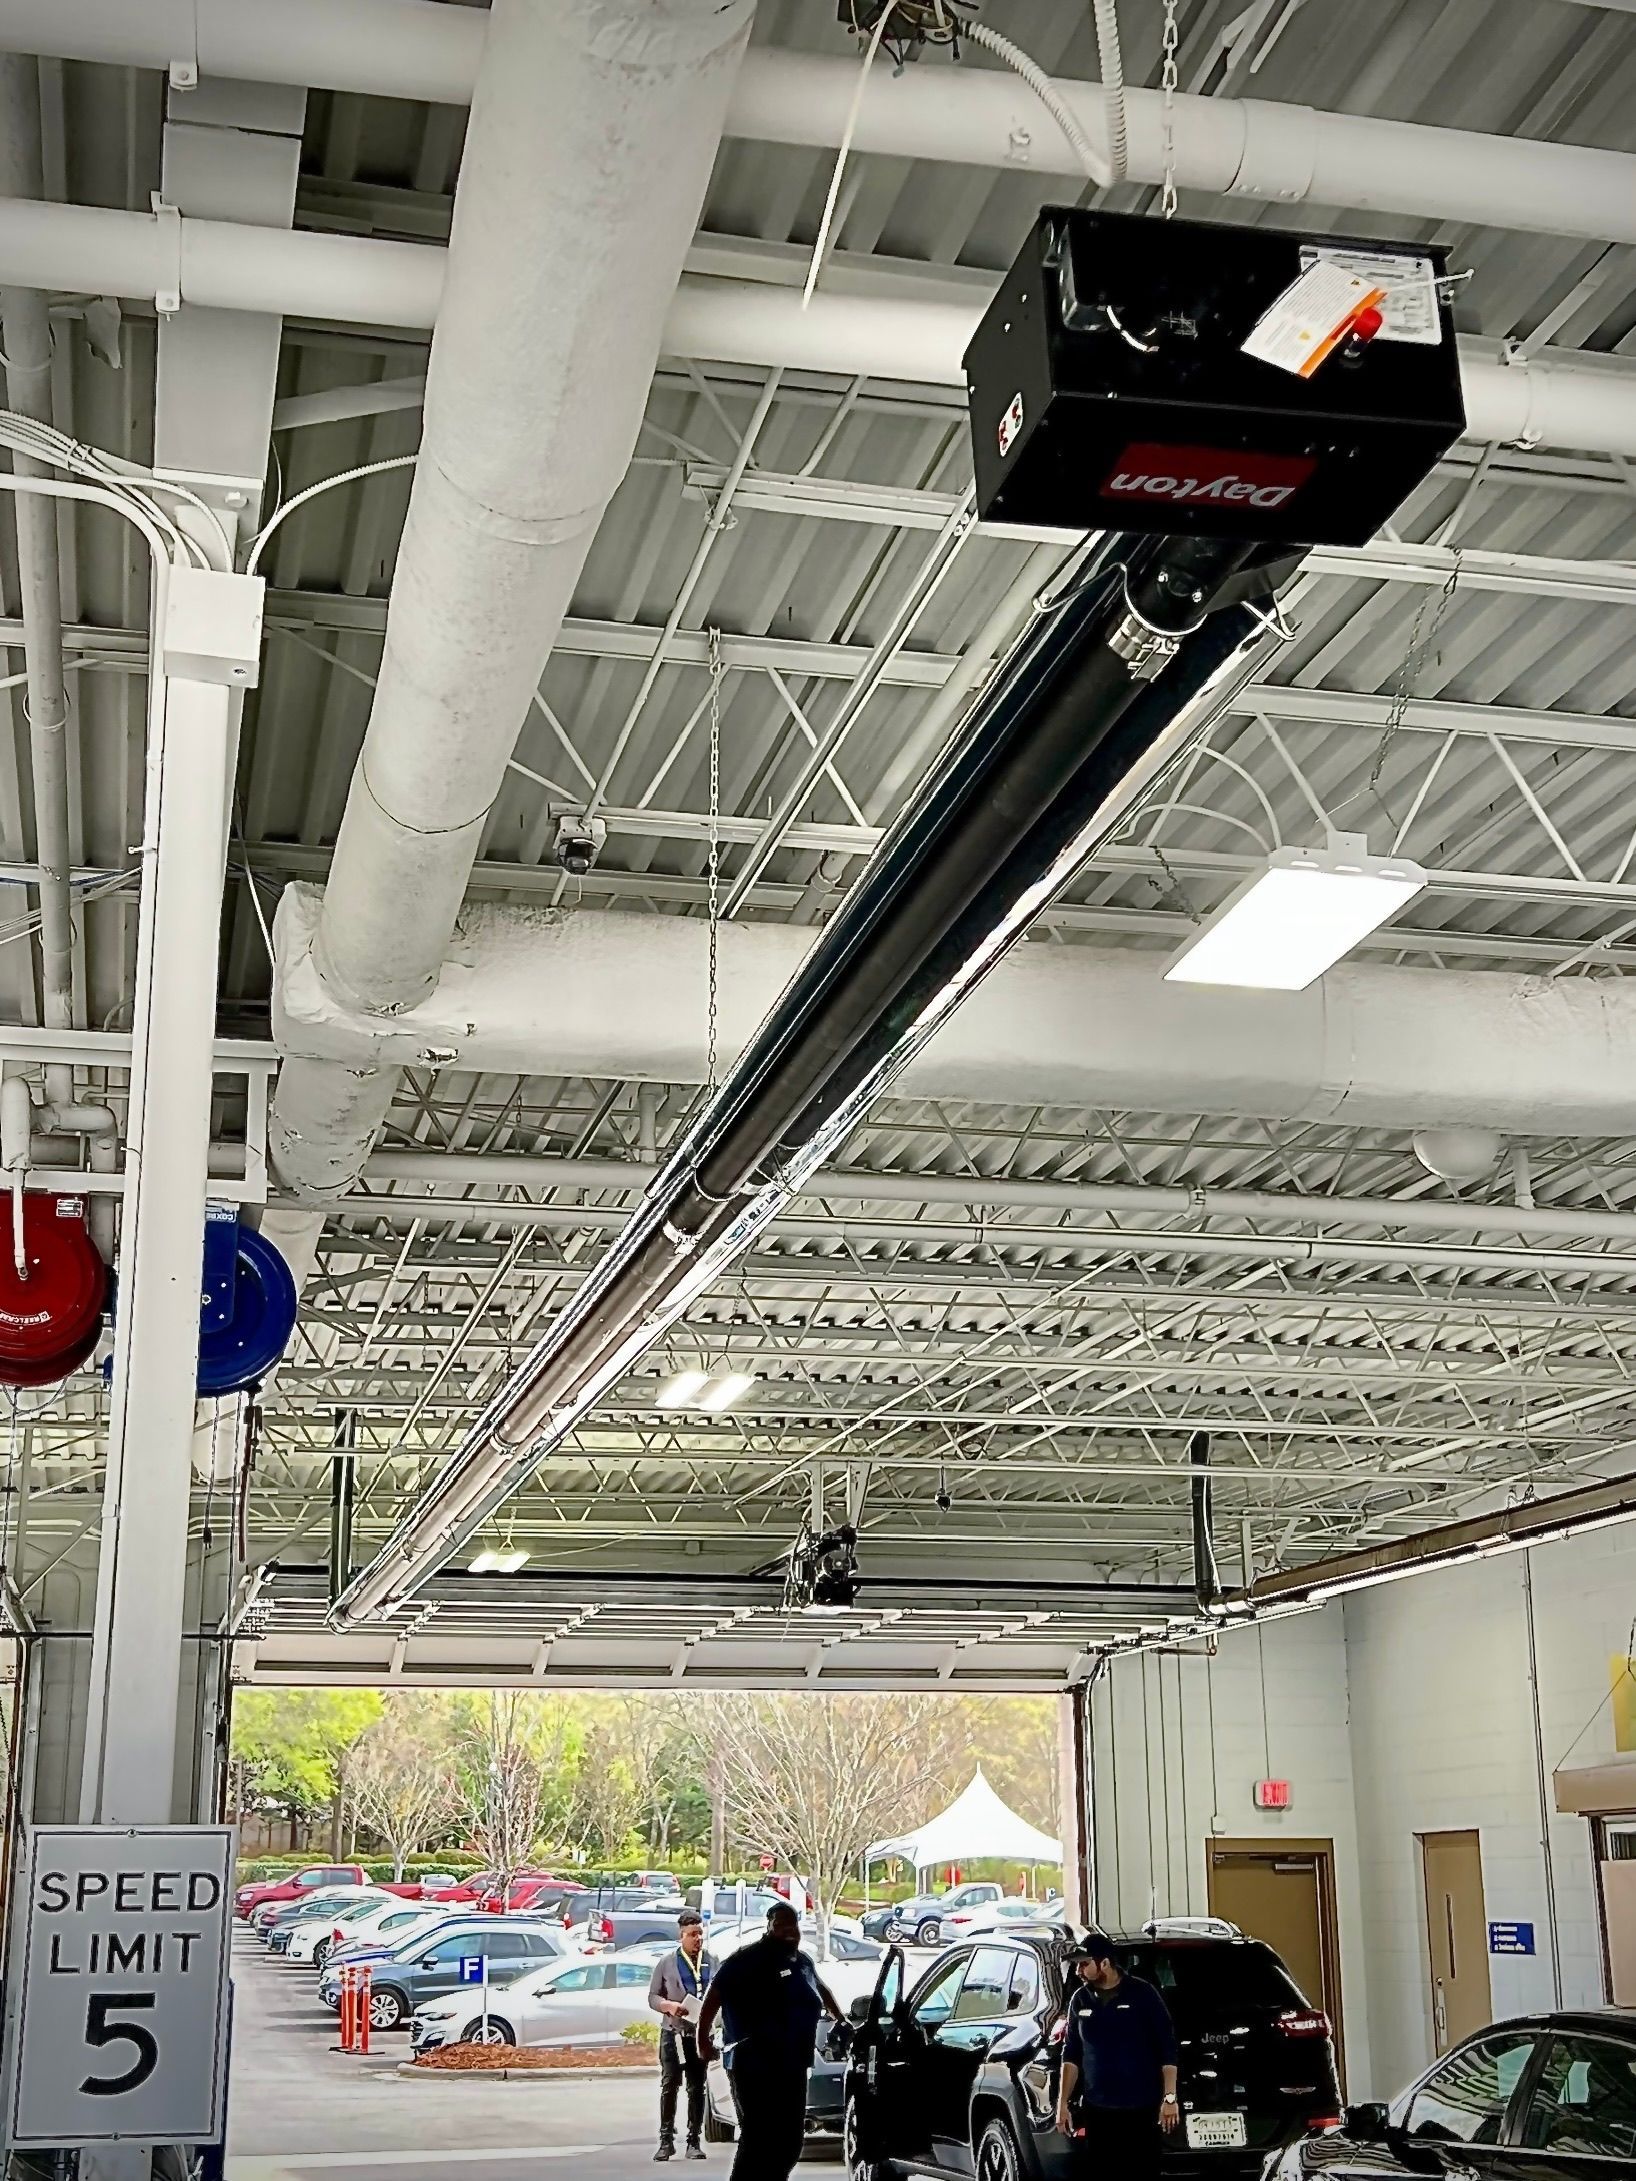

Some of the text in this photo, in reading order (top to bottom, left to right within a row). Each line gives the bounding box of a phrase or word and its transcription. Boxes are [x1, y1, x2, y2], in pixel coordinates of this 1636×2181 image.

[1110, 473, 1296, 507] Dayton
[37, 1871, 221, 1913] SPEED
[50, 1932, 202, 1974] LIMIT
[464, 1957, 480, 1980] F
[78, 1992, 159, 2096] 5
[1201, 2032, 1229, 2045] Jeep
